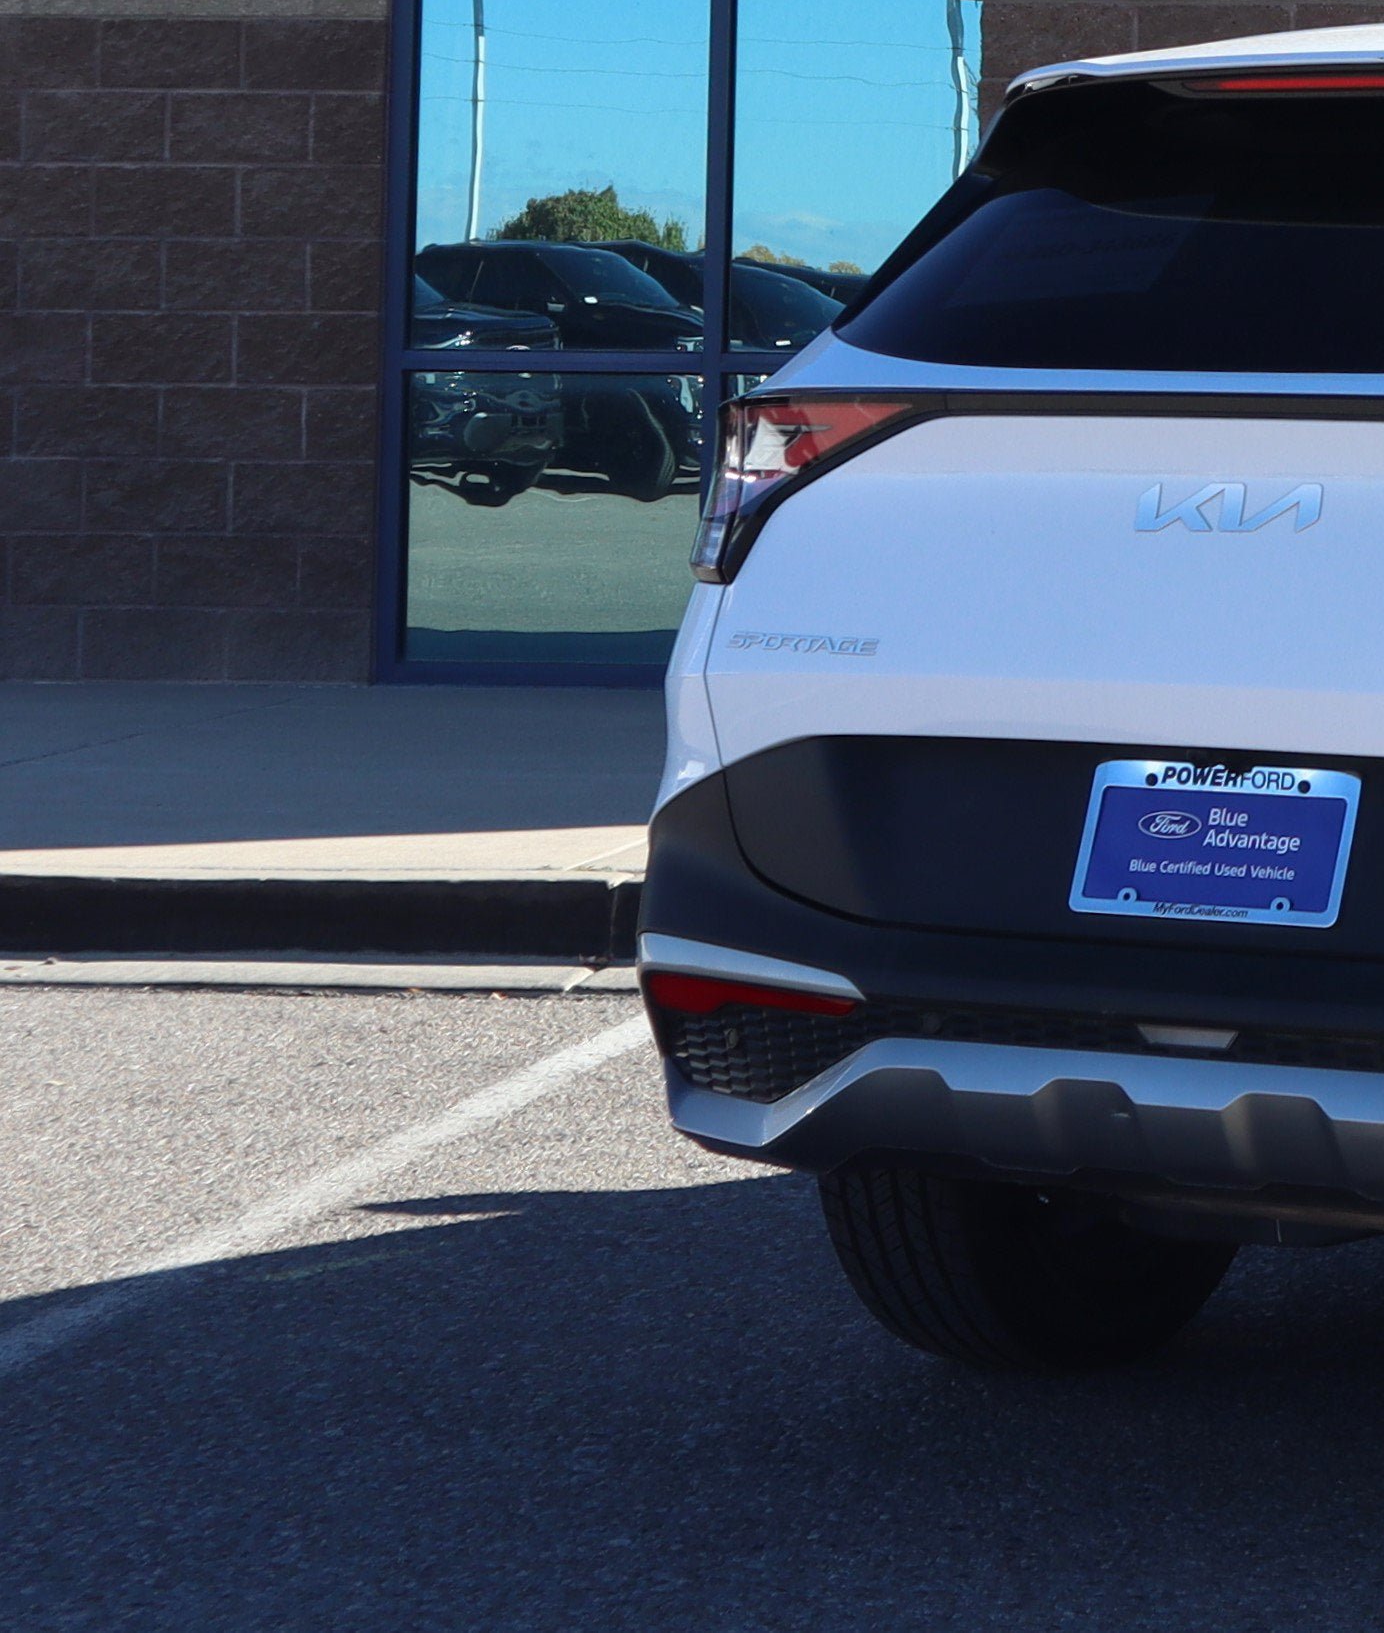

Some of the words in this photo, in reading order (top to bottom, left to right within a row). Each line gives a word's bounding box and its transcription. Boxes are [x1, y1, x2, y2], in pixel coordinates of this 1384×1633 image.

[1134, 482, 1324, 534] KIA
[727, 631, 880, 657] SPORTAGE
[1149, 814, 1191, 836] Ford
[1208, 807, 1249, 828] Blue
[1203, 829, 1301, 855] Advantage
[1129, 858, 1157, 873] Blue
[1159, 860, 1212, 877] Certified
[1214, 863, 1247, 879] Used
[1250, 865, 1296, 881] Vehicle
[1153, 900, 1249, 919] MyFordDealer.com
